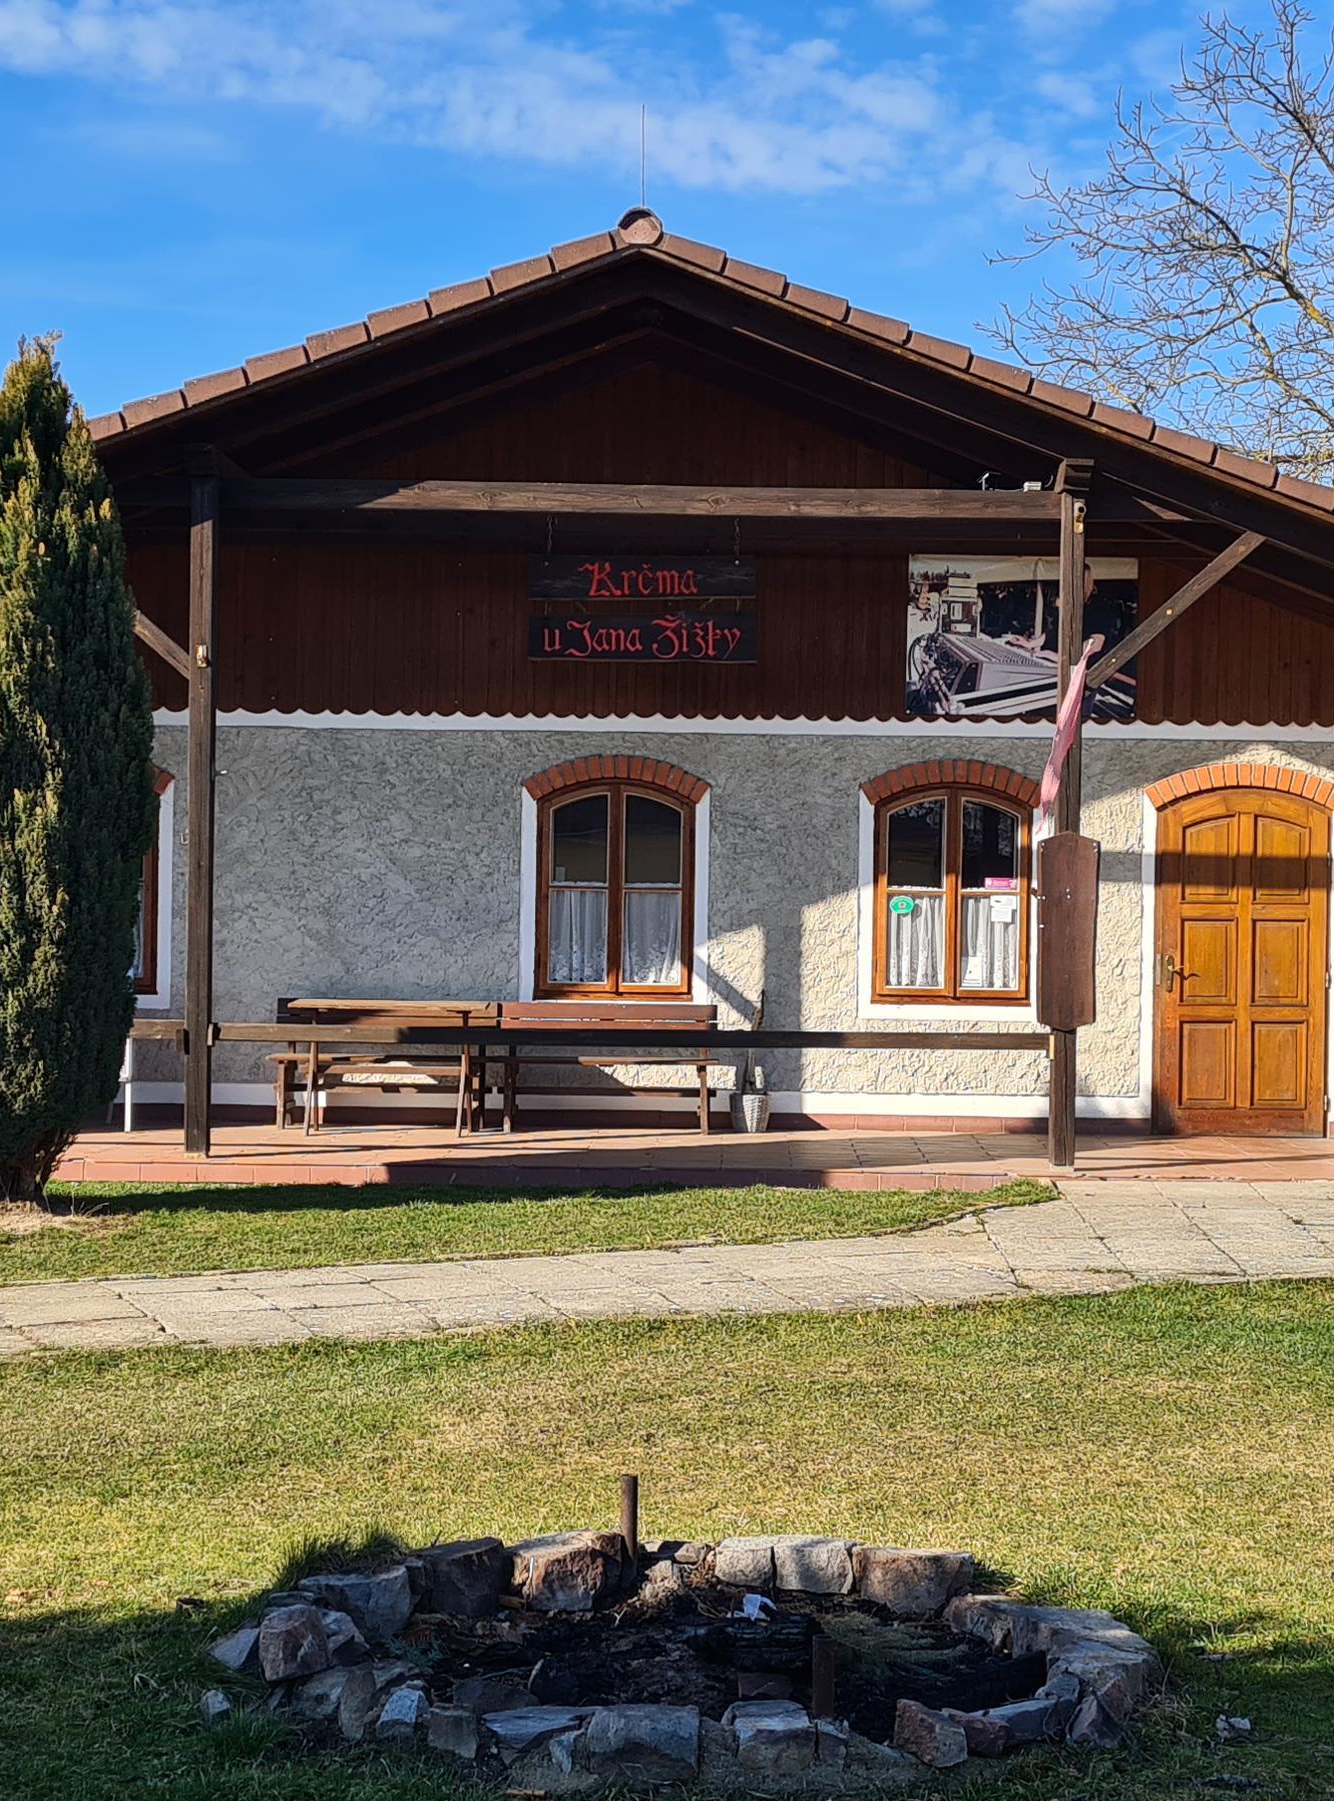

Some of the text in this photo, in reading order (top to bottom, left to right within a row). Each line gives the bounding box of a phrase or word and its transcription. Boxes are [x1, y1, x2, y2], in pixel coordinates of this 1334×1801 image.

[578, 562, 698, 597] Krčma
[543, 614, 741, 660] u Jana Žižky
